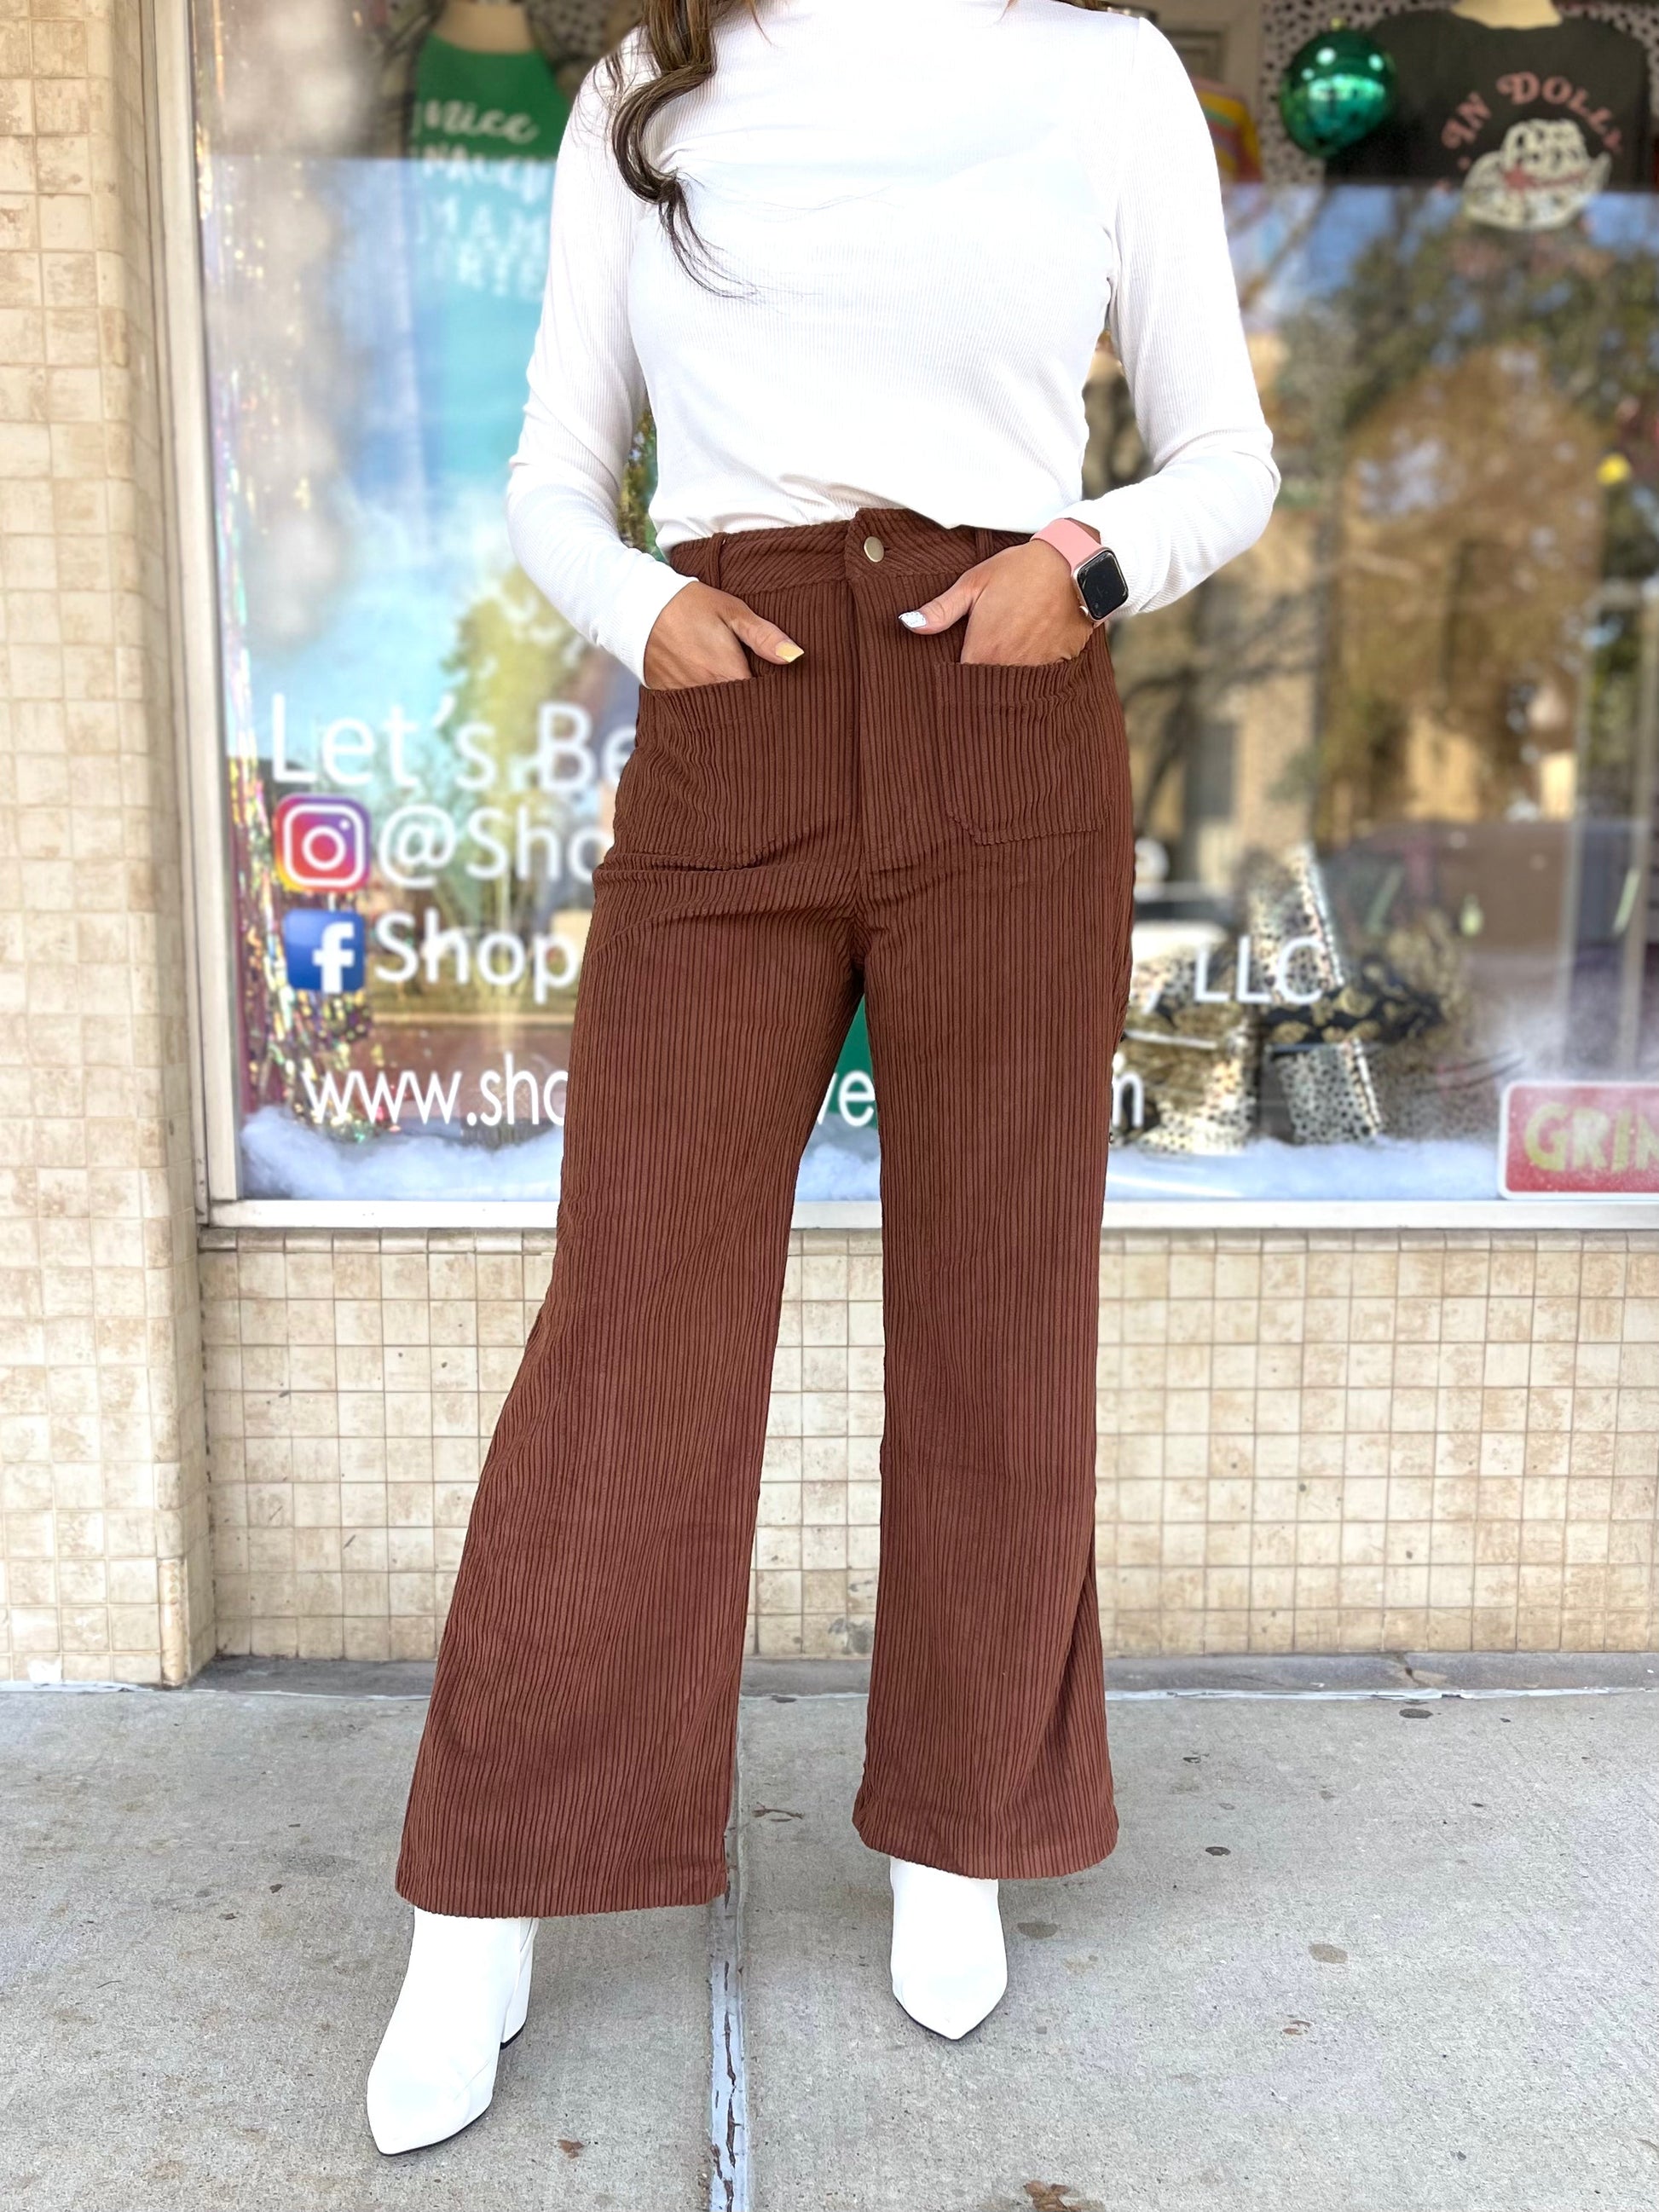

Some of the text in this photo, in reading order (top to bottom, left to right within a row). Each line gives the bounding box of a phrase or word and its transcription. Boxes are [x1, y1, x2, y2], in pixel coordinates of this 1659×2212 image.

[1441, 90, 1492, 151] IN
[271, 692, 495, 789] Let's
[375, 907, 1323, 1004] Shop LLC
